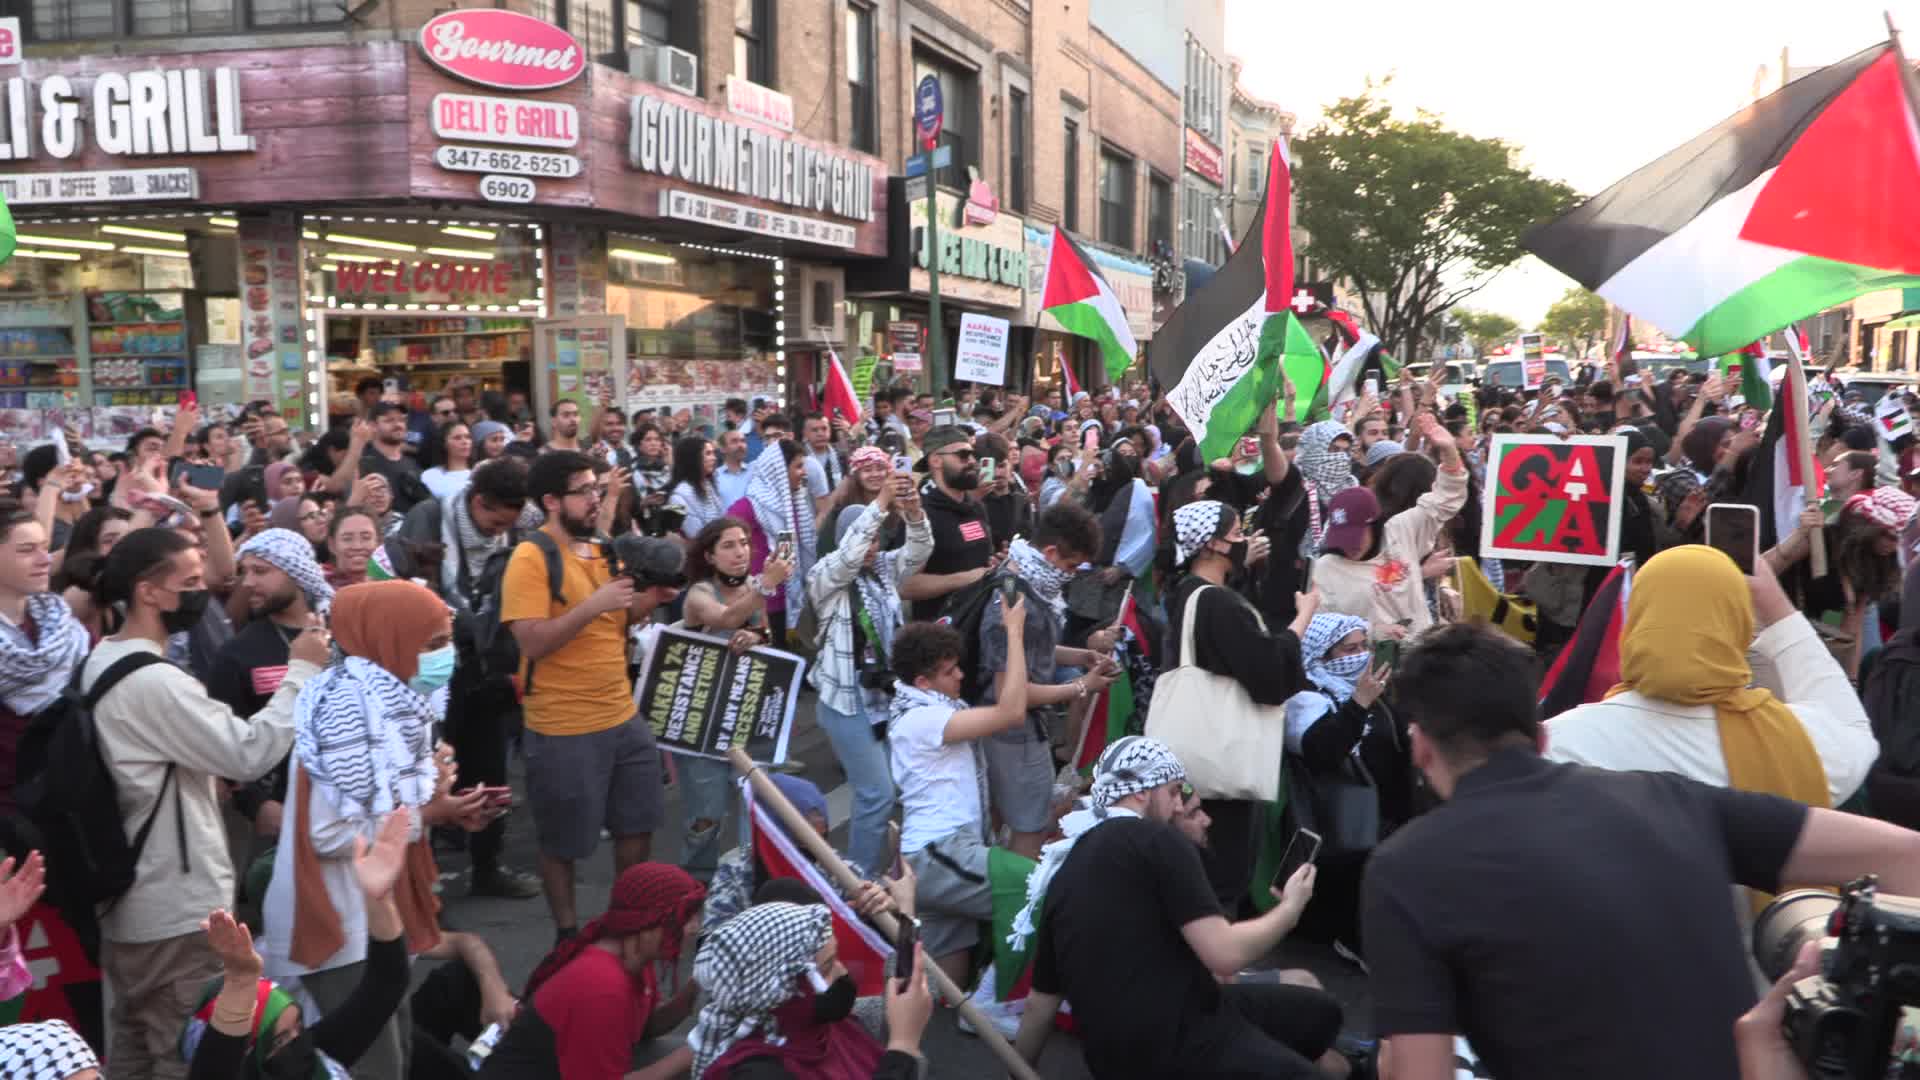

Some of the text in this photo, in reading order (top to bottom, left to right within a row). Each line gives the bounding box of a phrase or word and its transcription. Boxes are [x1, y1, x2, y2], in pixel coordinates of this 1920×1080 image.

[432, 20, 577, 71] Gourmet
[40, 75, 80, 158] &
[93, 67, 251, 155] GRILL
[439, 98, 574, 140] DELI & GRILL
[447, 148, 571, 174] 347-662-6251
[640, 96, 764, 197] GOURMET
[486, 180, 530, 199] 6902
[335, 260, 513, 294] WELCOME
[650, 670, 681, 736] NAKBA
[664, 644, 705, 741] RESISTANCE
[681, 648, 721, 745] AND RETURN
[715, 655, 752, 751] BY ANY MEANS
